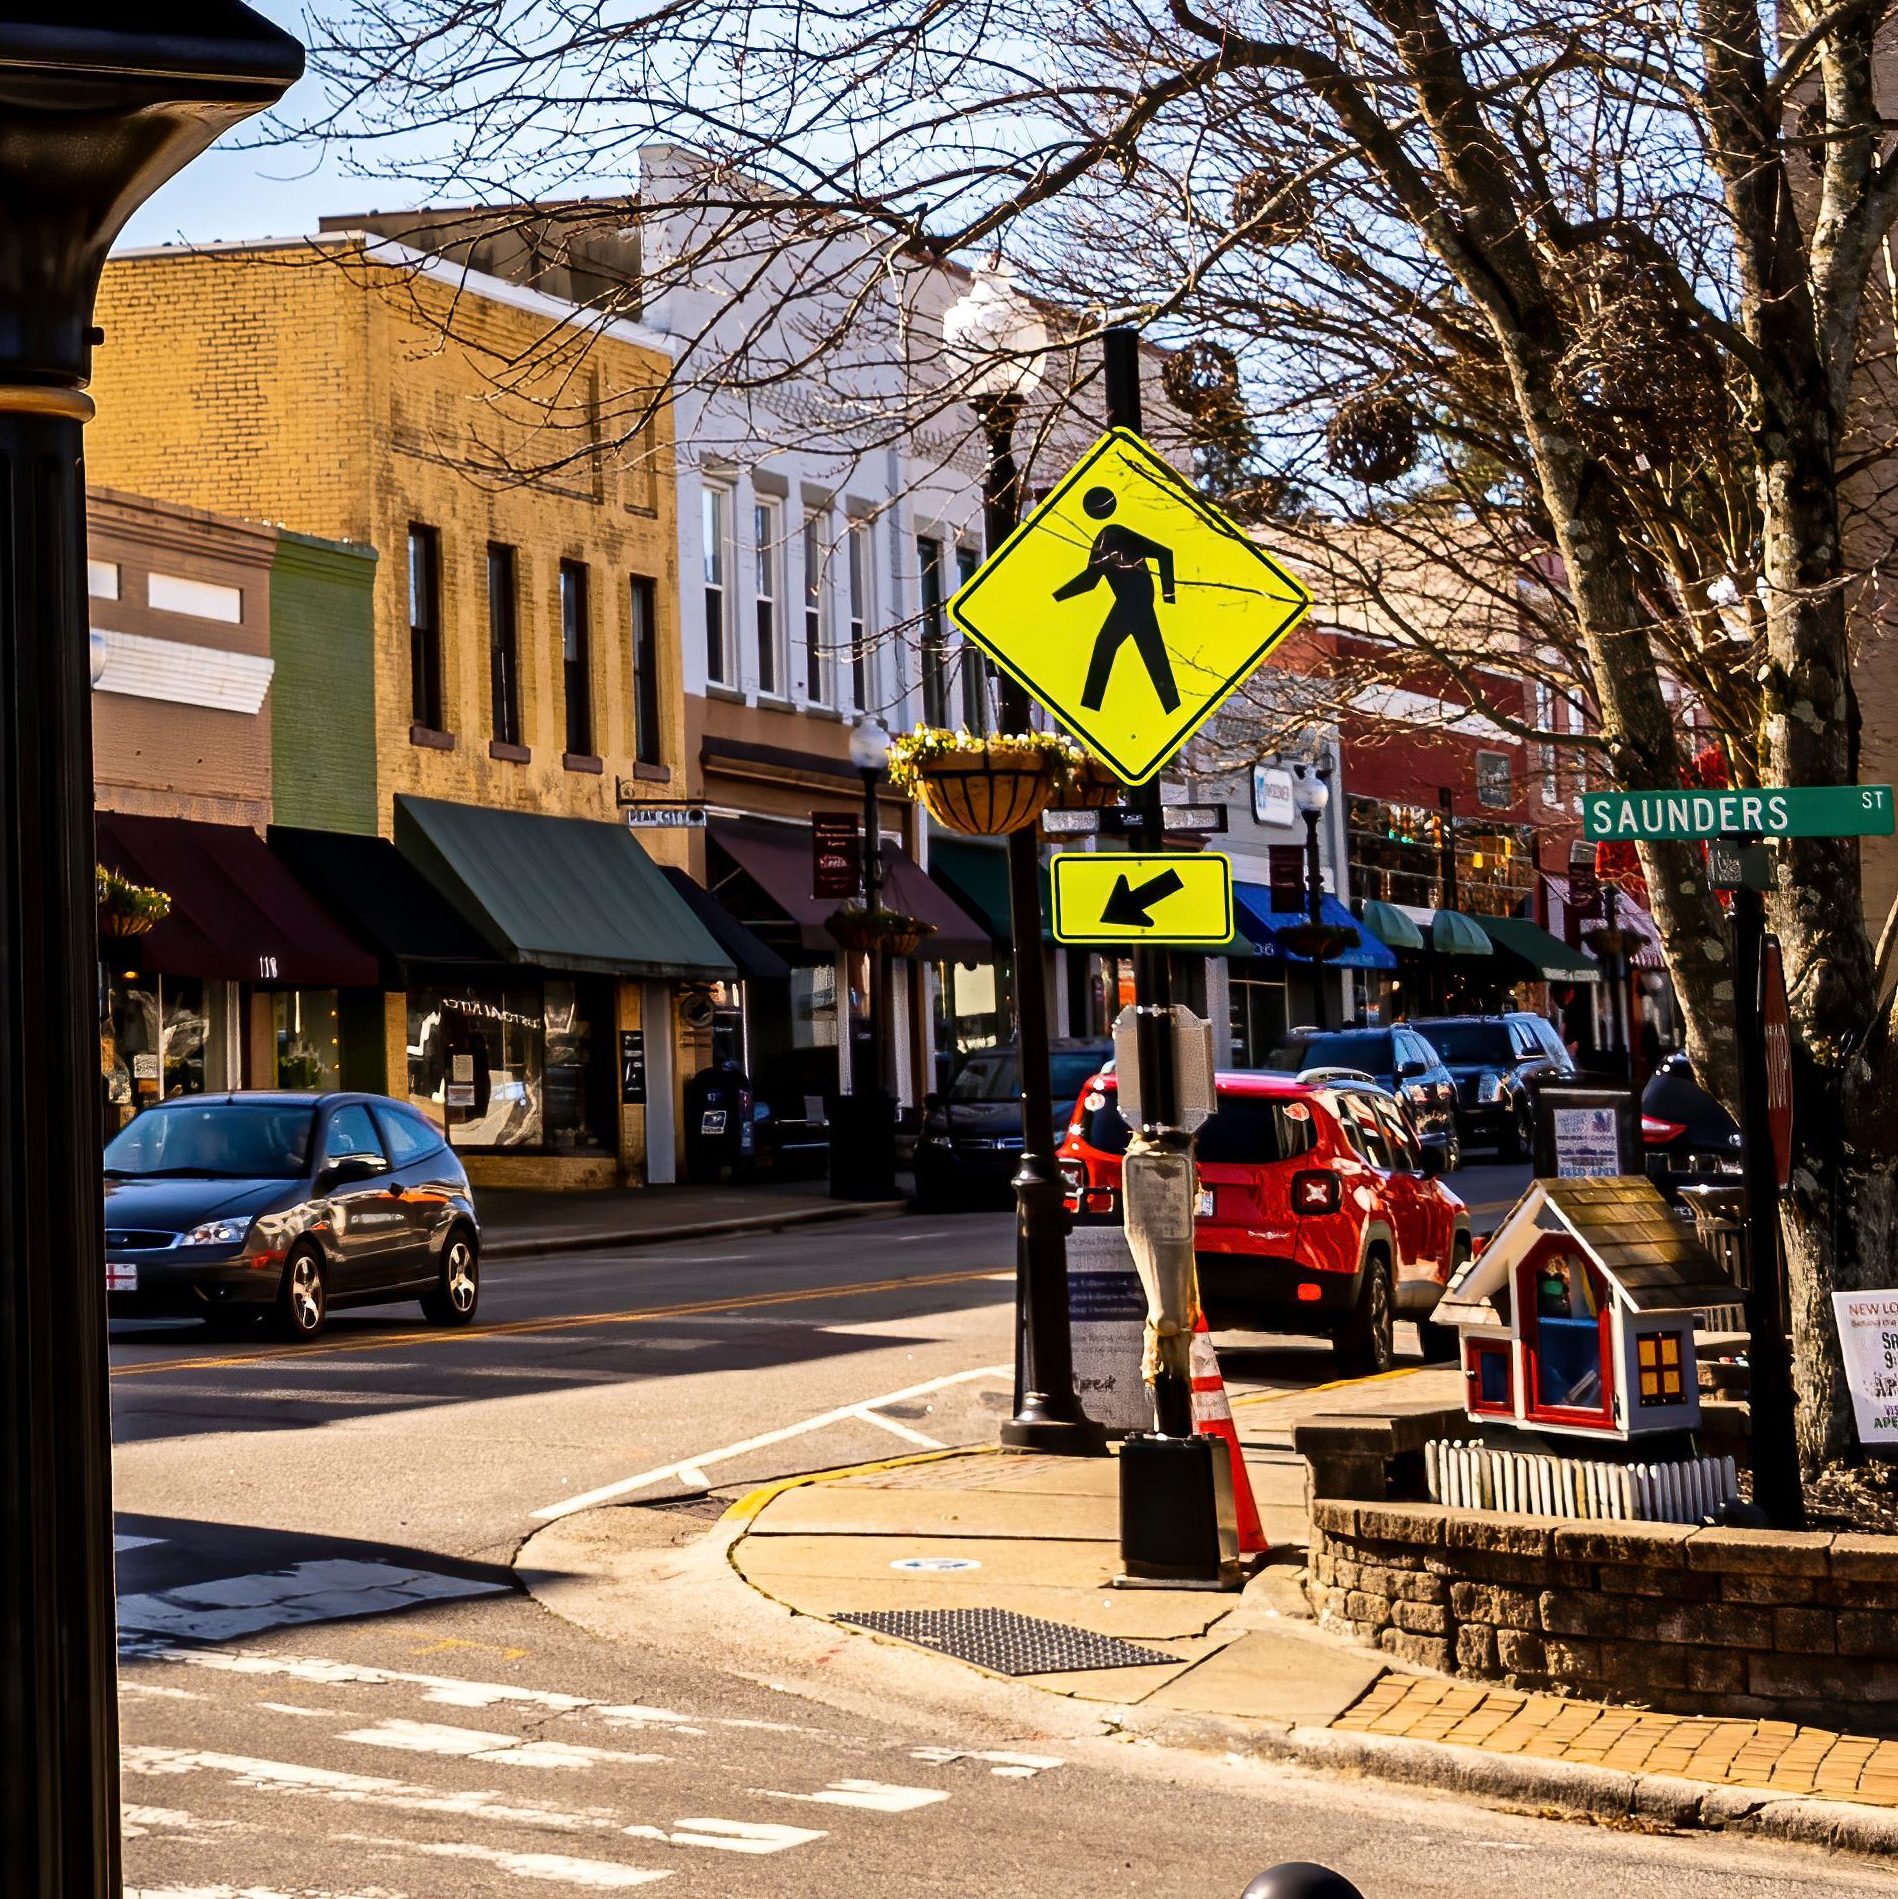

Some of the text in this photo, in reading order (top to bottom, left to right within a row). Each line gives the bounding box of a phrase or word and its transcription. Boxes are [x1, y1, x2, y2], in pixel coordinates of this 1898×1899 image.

[1593, 790, 1884, 834] SAUNDERS ST
[1848, 1302, 1879, 1316] NEW
